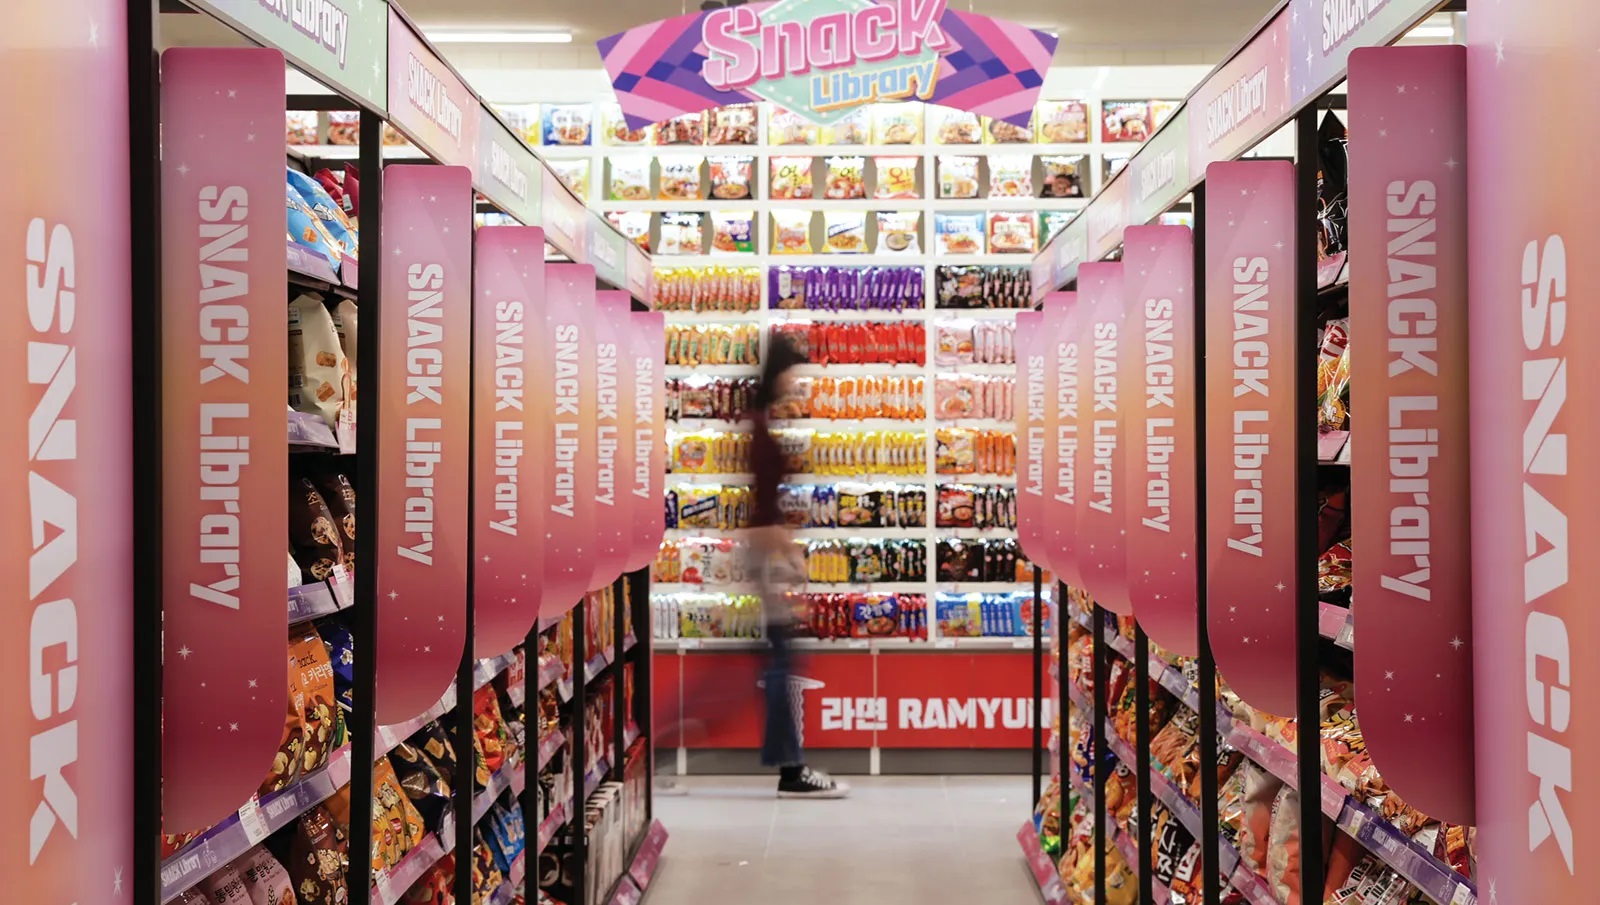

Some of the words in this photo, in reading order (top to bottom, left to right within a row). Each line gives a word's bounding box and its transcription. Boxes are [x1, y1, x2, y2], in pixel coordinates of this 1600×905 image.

[702, 0, 948, 88] Snack
[810, 60, 938, 111] Library
[408, 52, 436, 123] SNACK
[436, 80, 463, 150] Library
[1206, 86, 1235, 148] SNACK
[1236, 64, 1268, 127] Library
[199, 185, 250, 385] SNACK
[1386, 179, 1438, 379] SNACK
[407, 262, 444, 406] SNACK
[495, 301, 524, 412] SNACK
[555, 324, 578, 415] SNACK
[1094, 322, 1117, 412] SNACK
[1145, 299, 1174, 409] SNACK
[1233, 256, 1269, 398] SNACK
[597, 343, 617, 420] SNACK
[635, 357, 653, 423] SNACK
[1028, 355, 1045, 421] SNACK
[1058, 343, 1078, 419] SNACK
[189, 403, 250, 611] Library
[397, 418, 442, 566] Library
[489, 421, 524, 537] Library
[551, 423, 579, 517] Library
[594, 425, 618, 506] Library
[632, 428, 653, 498] Library
[1025, 427, 1045, 496] Library
[1054, 425, 1078, 505] Library
[1088, 420, 1117, 514] Library
[1142, 417, 1174, 532] Library
[1227, 410, 1269, 557] Library
[1380, 395, 1439, 602] Library
[25, 217, 78, 866] SNACK
[1521, 233, 1574, 876] SNACK
[821, 697, 888, 731] 라면
